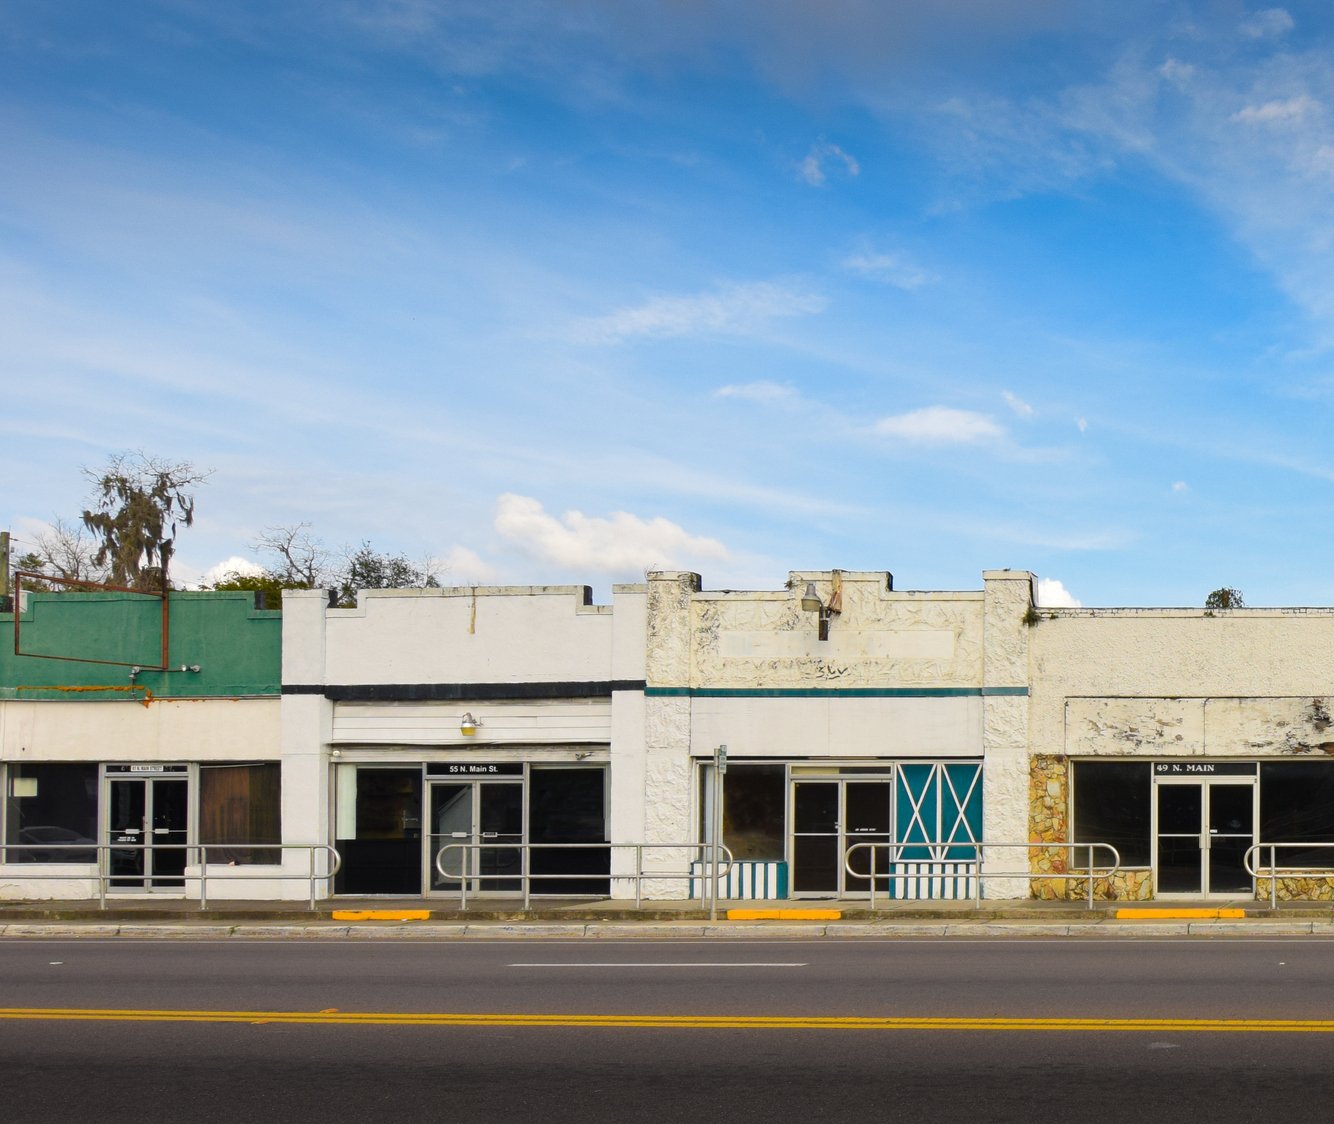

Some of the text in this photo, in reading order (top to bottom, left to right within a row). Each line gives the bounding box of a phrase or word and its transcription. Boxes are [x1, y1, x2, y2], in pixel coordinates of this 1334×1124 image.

[1156, 764, 1215, 772] 49 N. MAIN
